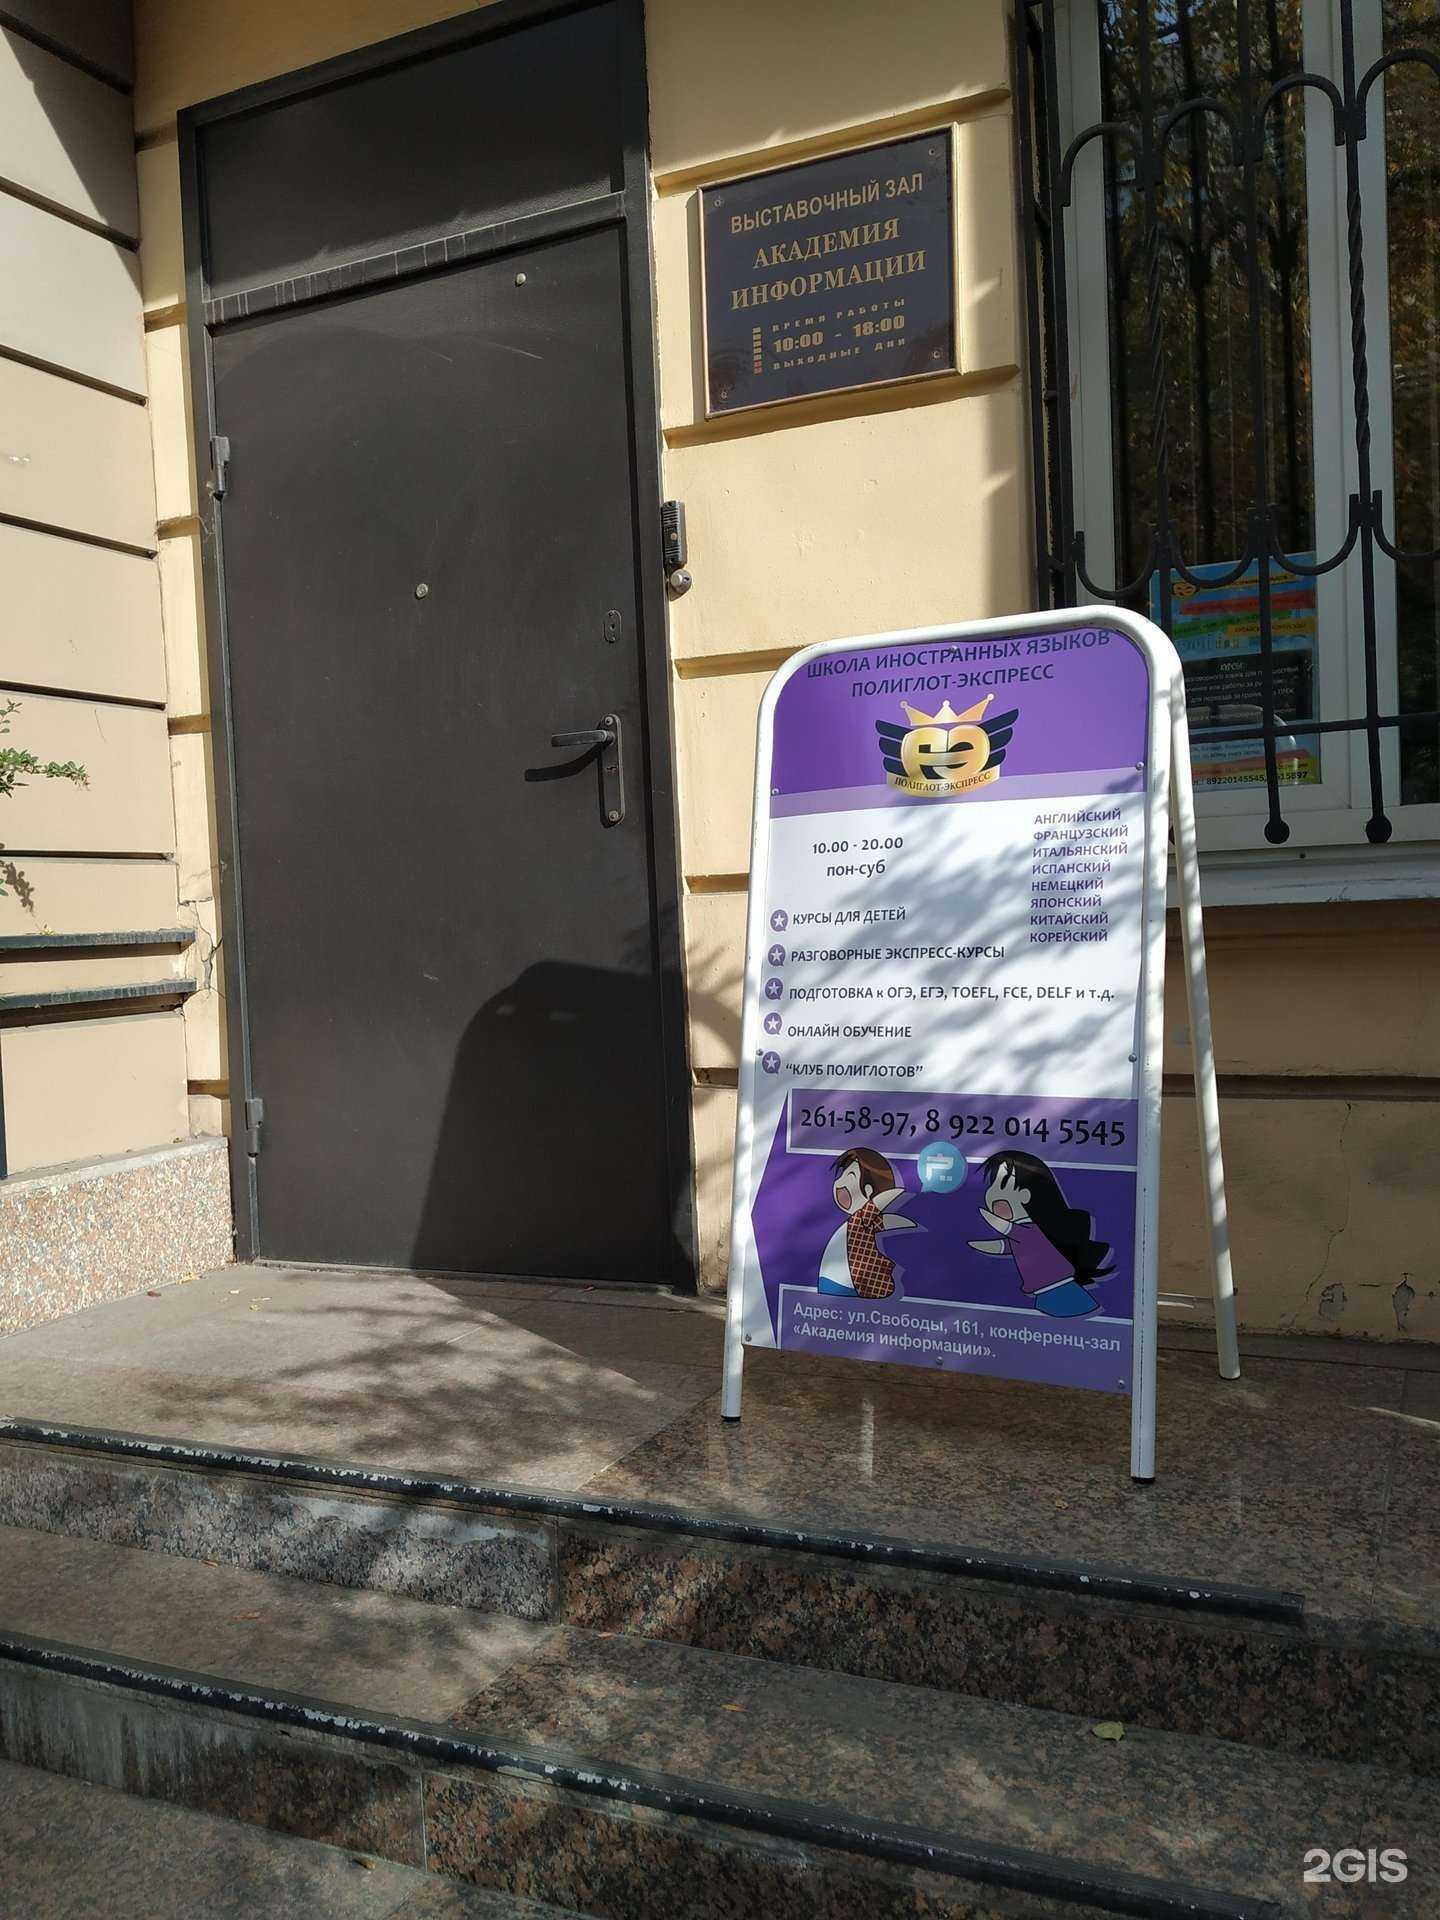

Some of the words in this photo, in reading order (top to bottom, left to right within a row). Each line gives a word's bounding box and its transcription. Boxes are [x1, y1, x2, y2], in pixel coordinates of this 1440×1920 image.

[731, 179, 880, 233] ВЫСТАВОЧНЫЙ
[886, 172, 923, 198] ЗАЛ
[752, 218, 900, 269] АКАДЕМИЯ
[730, 250, 927, 310] ИНФОРМАЦИИ
[773, 332, 824, 353] 10:00
[853, 315, 905, 337] 18:00
[807, 657, 870, 678] ШКОЛА
[876, 643, 1022, 671] ИНОСТРАННЫХ
[1026, 630, 1111, 655] ЯЗЫКОВ
[852, 664, 1054, 698] ПОЛИГЛОТ-ЭКСПРЕСС
[894, 771, 991, 791] ПОЛИГЛОТ-ЭКСПРЕСС
[1034, 808, 1121, 824] АНГЛИЙСКИЙ
[1033, 825, 1129, 841] ФРАНЦУЗСКИЙ
[812, 841, 849, 854] 10.00
[861, 837, 904, 851] 20.00
[1032, 842, 1128, 858] ИТАЛЬЯНСКИЙ
[826, 859, 886, 878] пон-суб
[1032, 859, 1111, 875] ИСПАНСКИЙ
[1031, 877, 1104, 892] НЕМЕЦКИЙ
[1030, 894, 1102, 909] ЯПОНСКИЙ
[793, 911, 832, 925] КУРСЫ
[834, 910, 860, 925] ДЛЯ
[863, 906, 906, 924] ДЕТЕЙ
[1030, 911, 1109, 926] КИТАЙСКИЙ
[1029, 928, 1108, 943] КОРЕЙСКИЙ
[790, 948, 882, 962] РАЗГОВОРНЫЕ
[885, 946, 1005, 961] ЭКСПРЕСС-КУРСЫ
[789, 986, 874, 1002] ПОДГОТОВКА
[887, 986, 917, 1001] ОГЭ,
[920, 986, 947, 1001] ЕГЭ,
[953, 986, 999, 1001] TOEFL,
[1003, 986, 1032, 1001] FCE,
[1037, 986, 1073, 999] DELF
[1076, 988, 1085, 999] и
[1089, 987, 1115, 1002] т.д.
[787, 1022, 839, 1038] ОНЛАЙН
[842, 1025, 912, 1039] ОБУЧЕНИЕ
[800, 1105, 917, 1137] 261-58-97,
[925, 1109, 940, 1133] 8
[949, 1115, 995, 1139] 922
[1004, 1116, 1050, 1143] 014
[1058, 1118, 1126, 1147] 5545
[793, 1301, 843, 1323] Адрес:
[953, 1318, 984, 1338] 161,
[989, 1324, 1121, 1353] конференц-зал
[792, 1321, 875, 1345] «Академия
[879, 1333, 997, 1359] информации».
